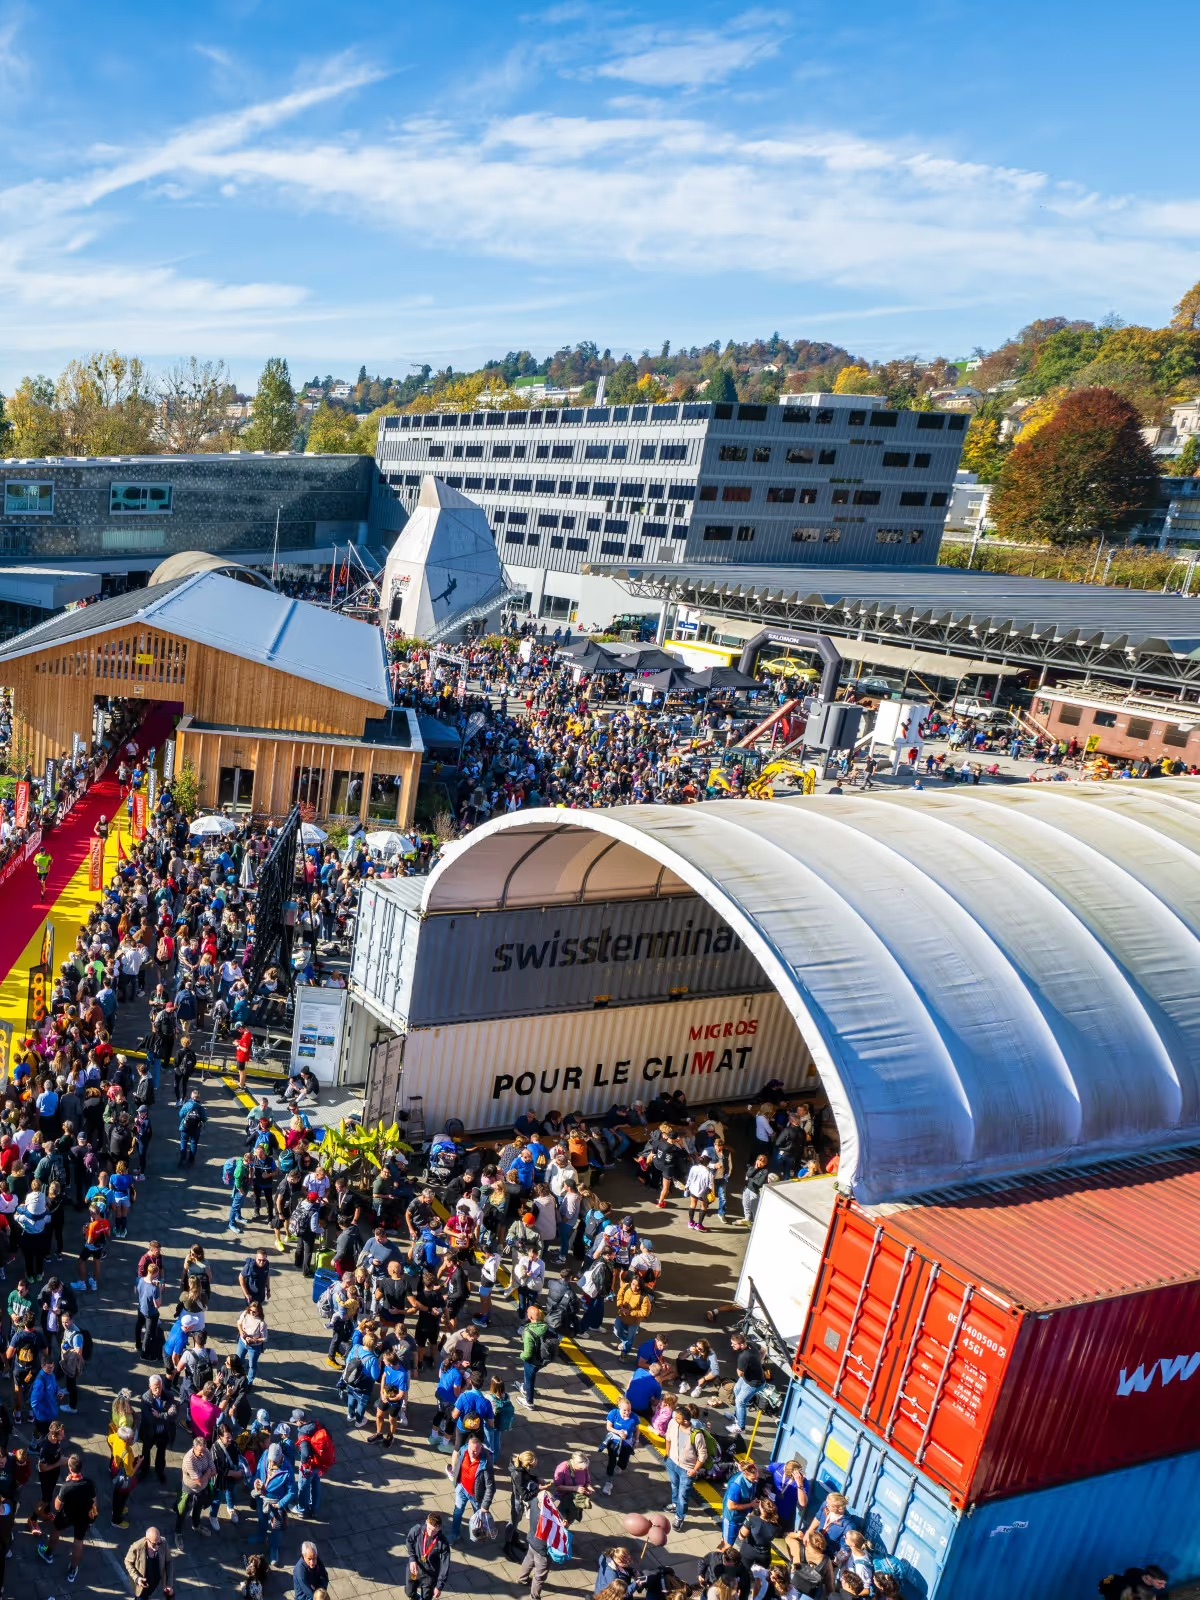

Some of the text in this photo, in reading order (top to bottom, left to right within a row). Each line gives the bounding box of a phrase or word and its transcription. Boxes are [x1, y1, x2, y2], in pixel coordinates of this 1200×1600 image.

[767, 634, 800, 643] SALOMON
[46, 760, 54, 797] SALOMON
[689, 1019, 759, 1041] MIGROS
[493, 1046, 753, 1099] POUR LE CLIMAT
